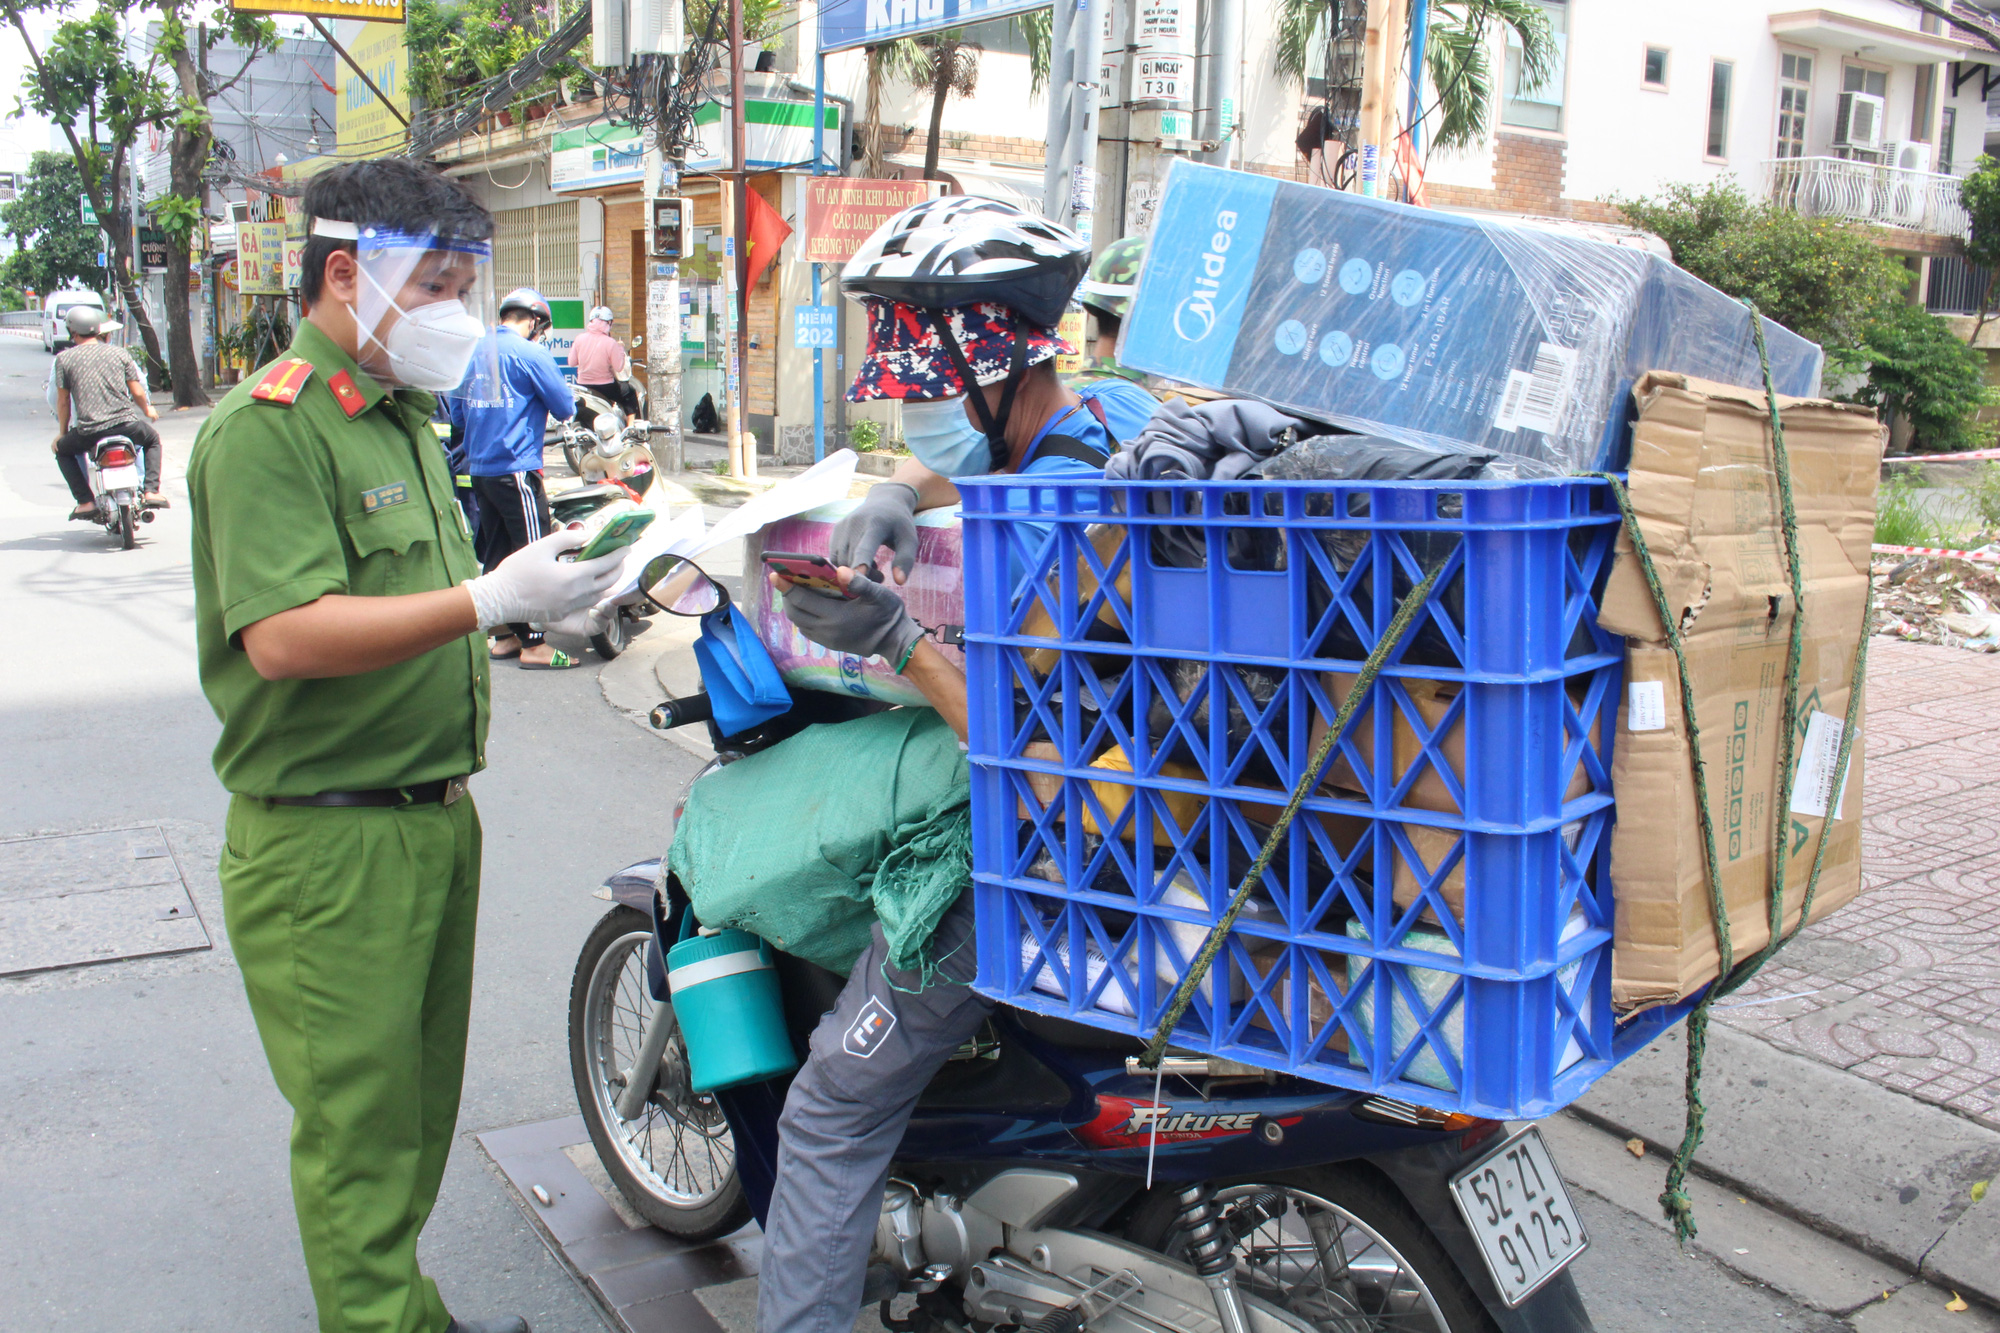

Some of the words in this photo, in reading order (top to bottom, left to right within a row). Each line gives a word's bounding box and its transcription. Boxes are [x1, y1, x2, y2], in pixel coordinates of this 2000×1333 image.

[827, 188, 839, 204] AN
[841, 188, 862, 206] NINH
[865, 189, 885, 207] KHU
[885, 186, 905, 207] DÂN
[832, 209, 851, 229] CÁC
[853, 214, 873, 233] LOẠI
[242, 226, 258, 253] GÀ
[811, 232, 842, 254] KHÔNG
[243, 260, 259, 280] TA
[1174, 210, 1238, 342] Midea
[1369, 261, 1384, 300] Oscillation
[1377, 268, 1391, 299] function
[1427, 267, 1440, 297] function
[799, 308, 833, 324] HẺM
[797, 328, 834, 344] 202
[1350, 339, 1363, 368] Remote
[1359, 342, 1370, 369] control
[1499, 1196, 1571, 1284] 9125
